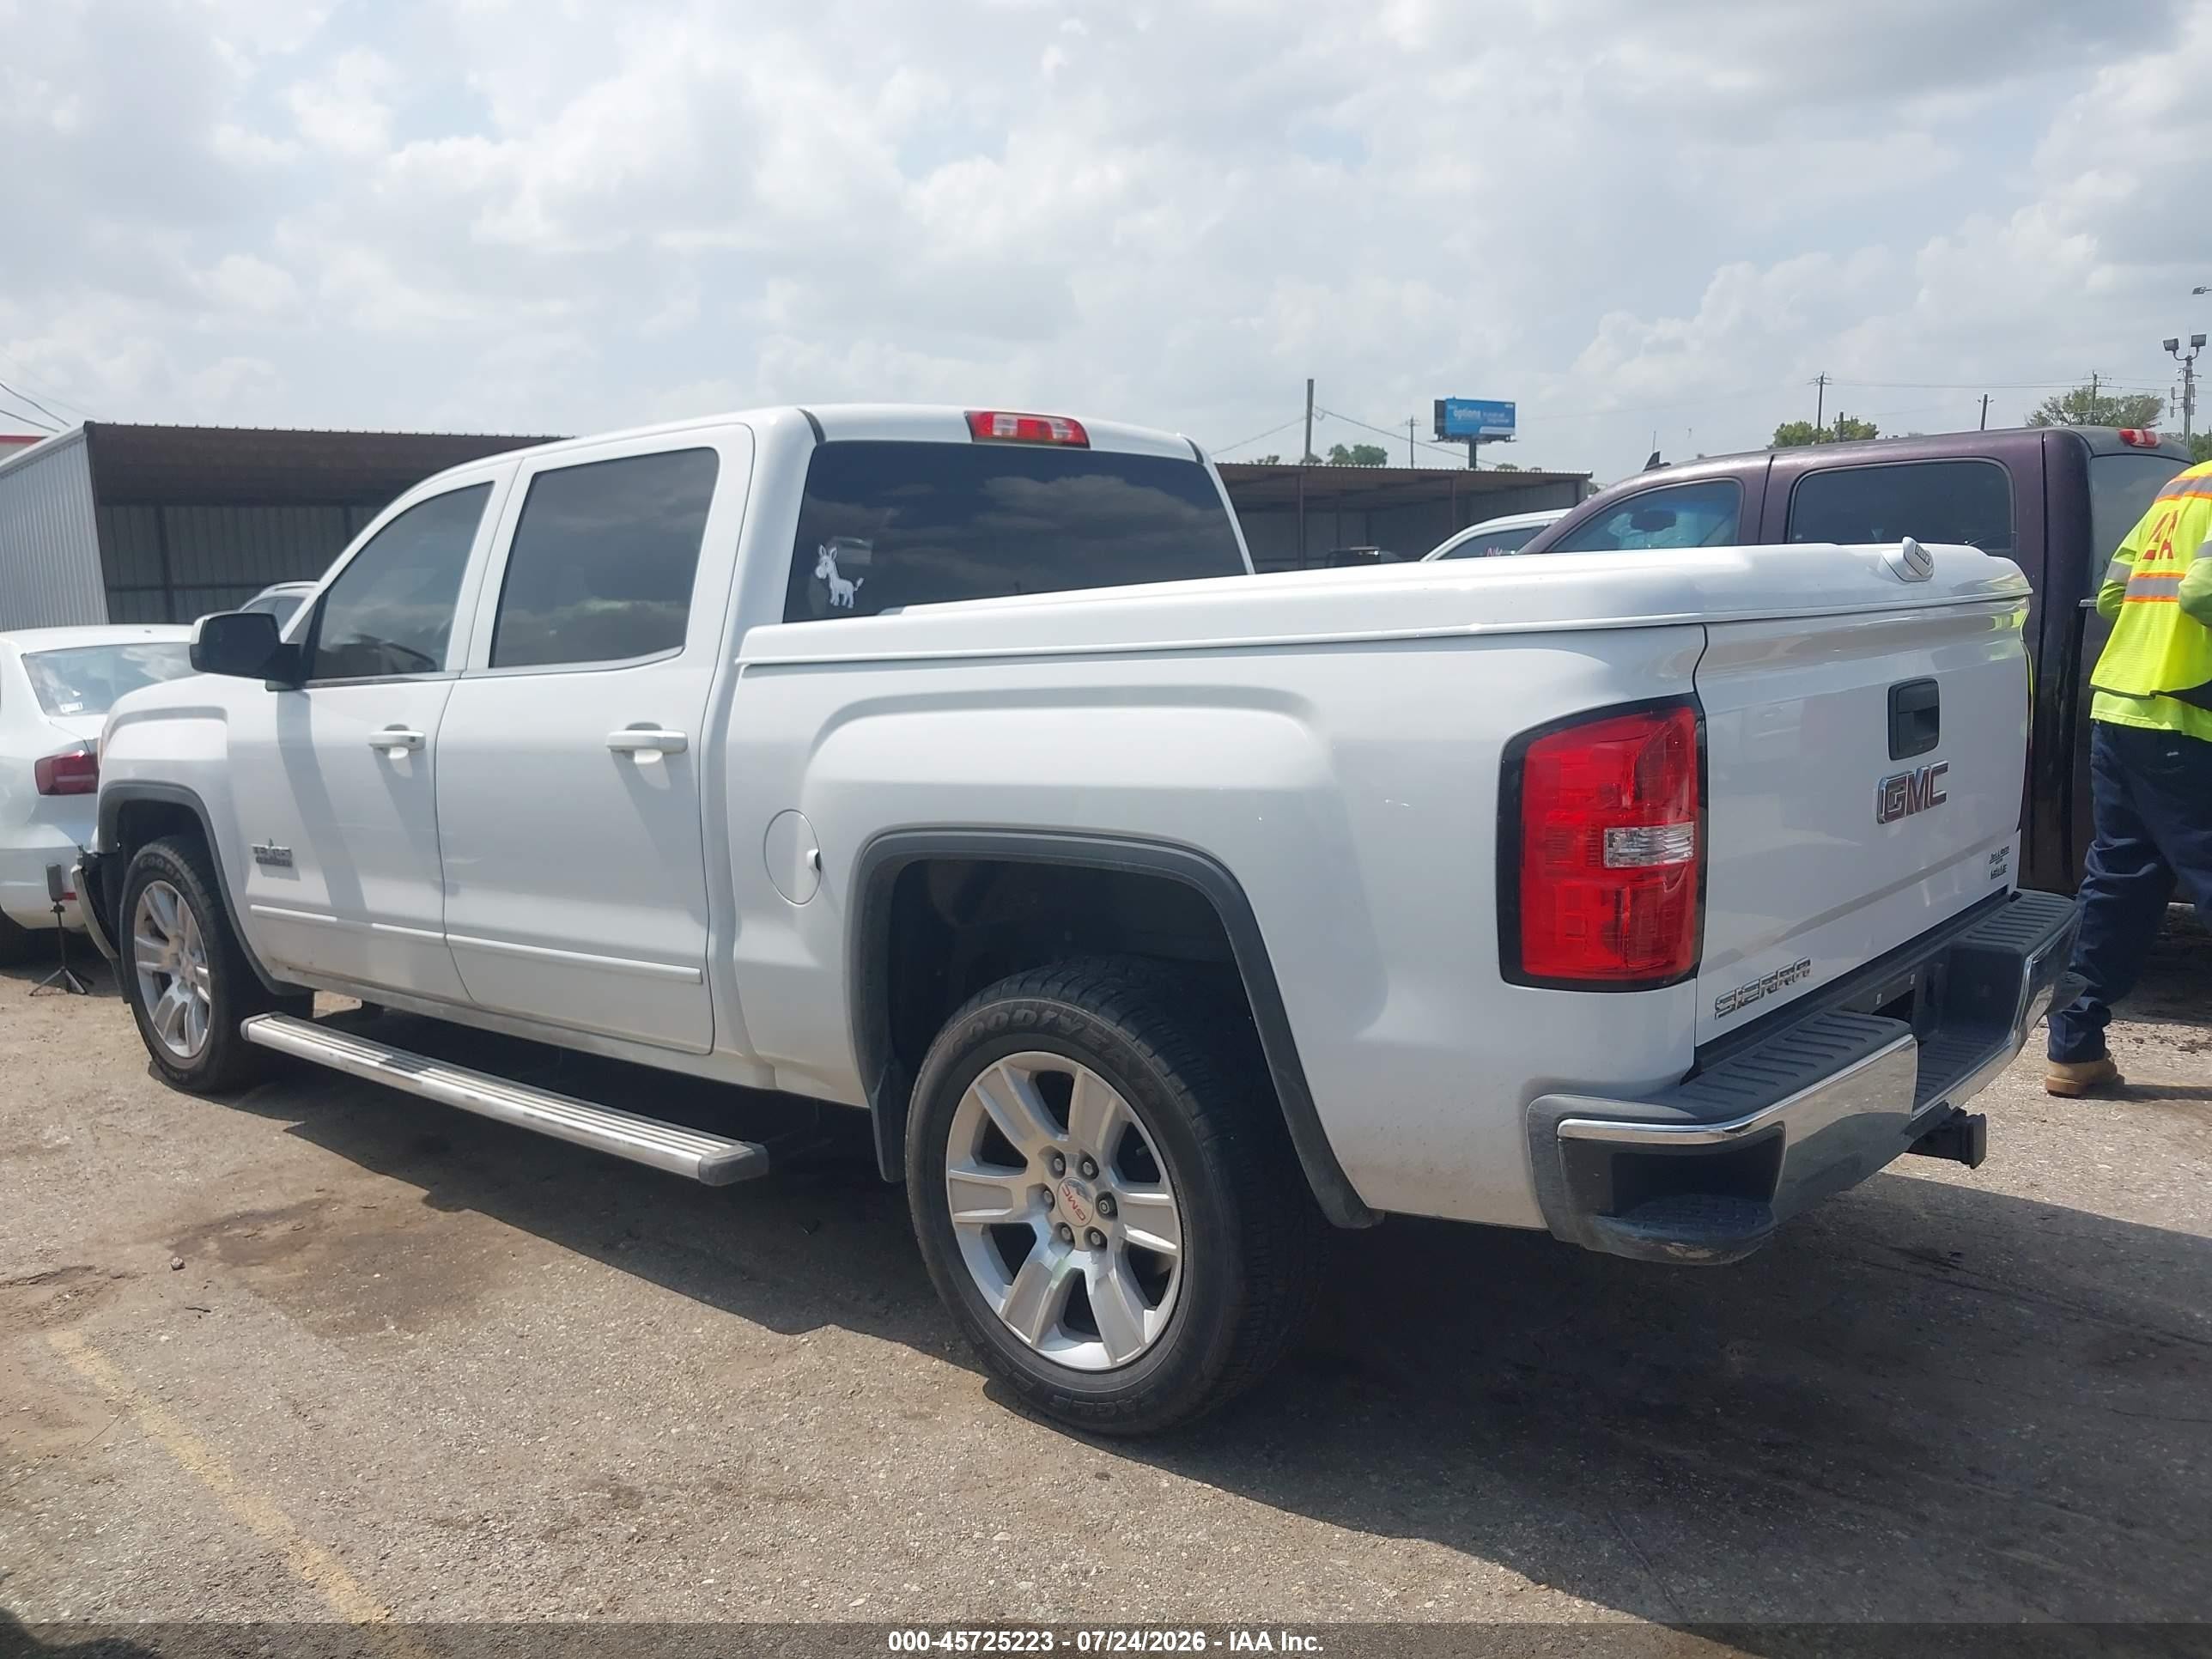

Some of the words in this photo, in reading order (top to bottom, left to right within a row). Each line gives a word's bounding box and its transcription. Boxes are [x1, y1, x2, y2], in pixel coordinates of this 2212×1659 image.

[1876, 760, 1949, 825] GMC
[1714, 956, 1811, 1020] SIERRA
[1060, 1182, 1086, 1221] GMC
